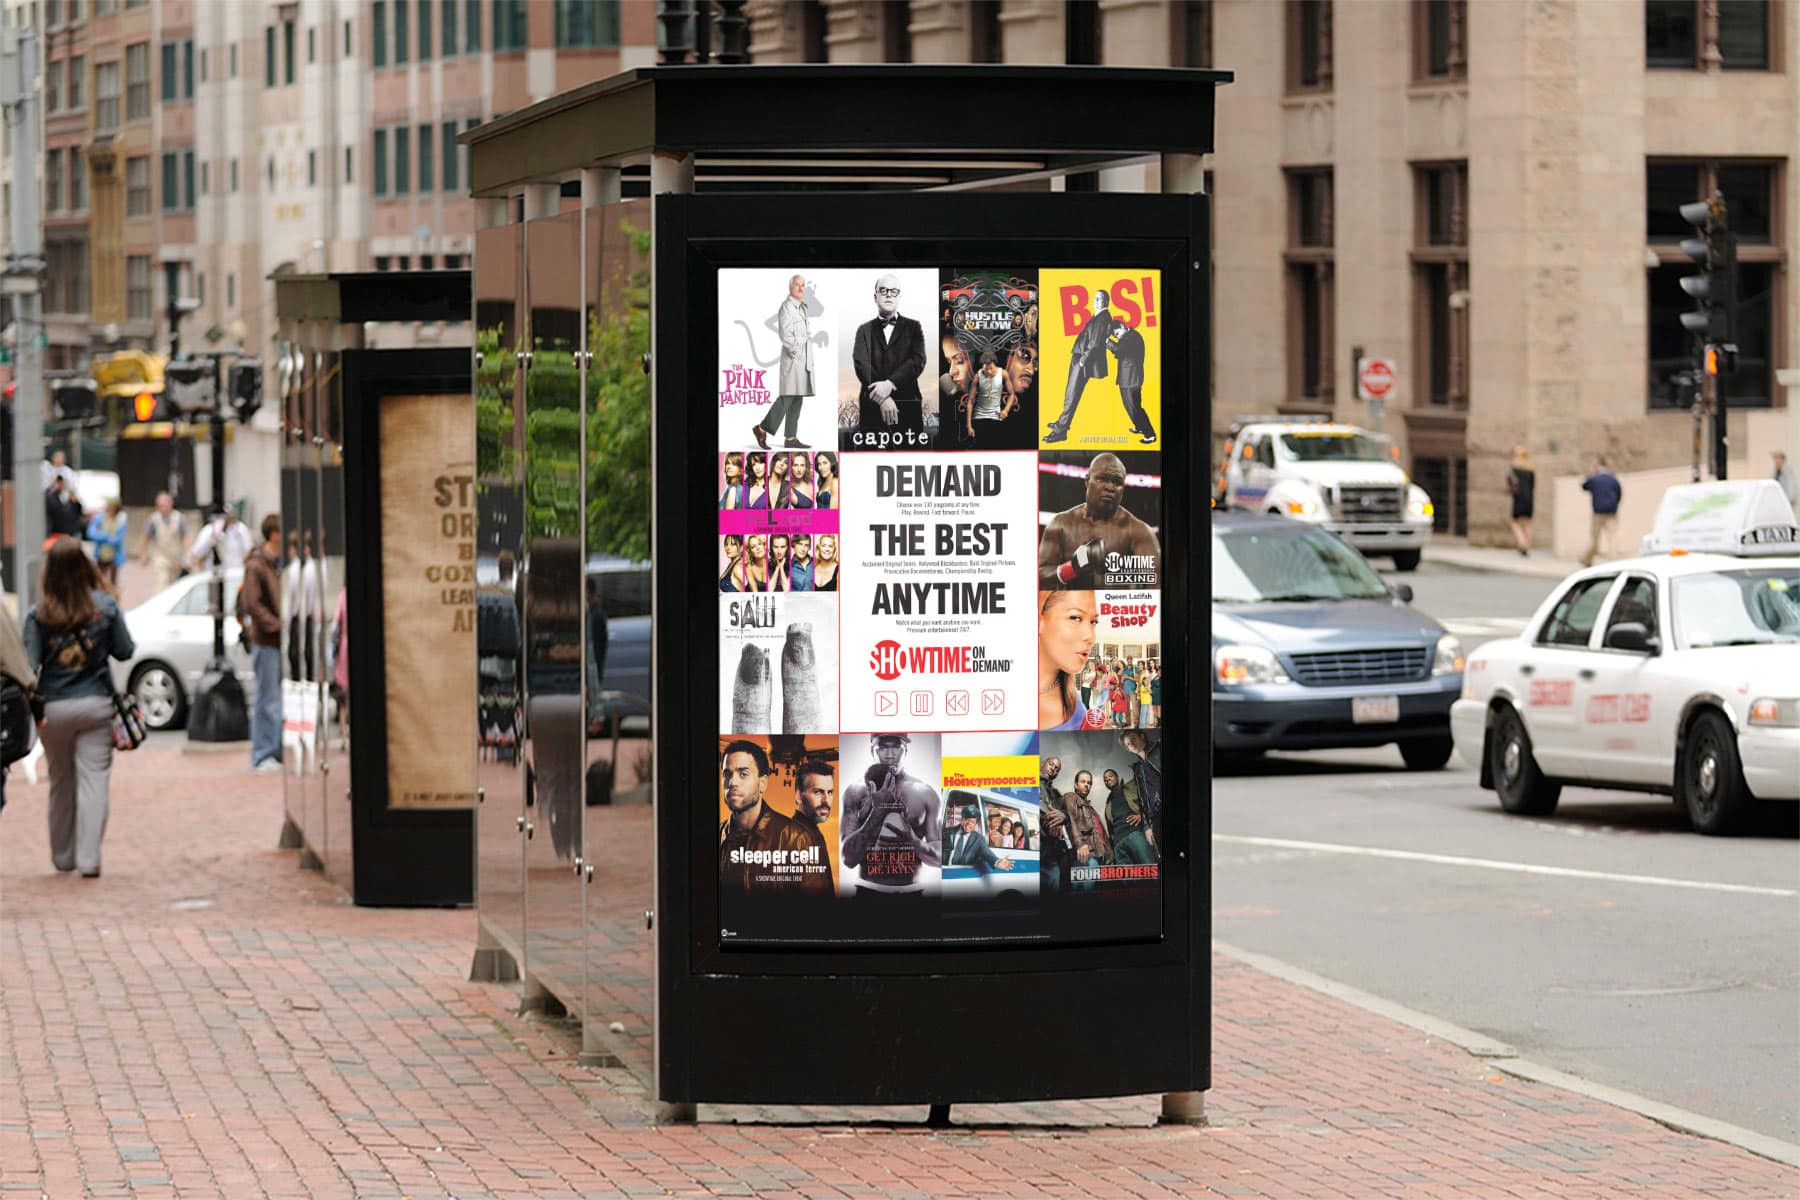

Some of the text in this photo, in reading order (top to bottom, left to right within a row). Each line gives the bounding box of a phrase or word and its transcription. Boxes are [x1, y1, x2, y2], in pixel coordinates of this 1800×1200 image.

[965, 311, 1013, 321] HUSTLE
[722, 368, 767, 392] PINK
[719, 390, 772, 408] PANTHER
[852, 428, 929, 448] capote
[876, 464, 1002, 498] DEMAND
[767, 510, 778, 525] L
[869, 522, 1009, 556] THE BEST
[1762, 527, 1789, 542] TAXI
[1105, 551, 1156, 573] SHOWTIME
[1106, 574, 1155, 583] BOXING
[871, 581, 1006, 615] ANYTIME
[1104, 592, 1153, 601] Queen Latifah
[730, 594, 776, 629] SAW
[1100, 602, 1158, 618] Beauty
[1111, 615, 1148, 628] Shop
[870, 639, 972, 681] SHOWTIME
[972, 646, 986, 660] ON
[943, 776, 1037, 787] Honeymooners
[730, 846, 820, 868] sleeper cell
[772, 863, 827, 873] american terror
